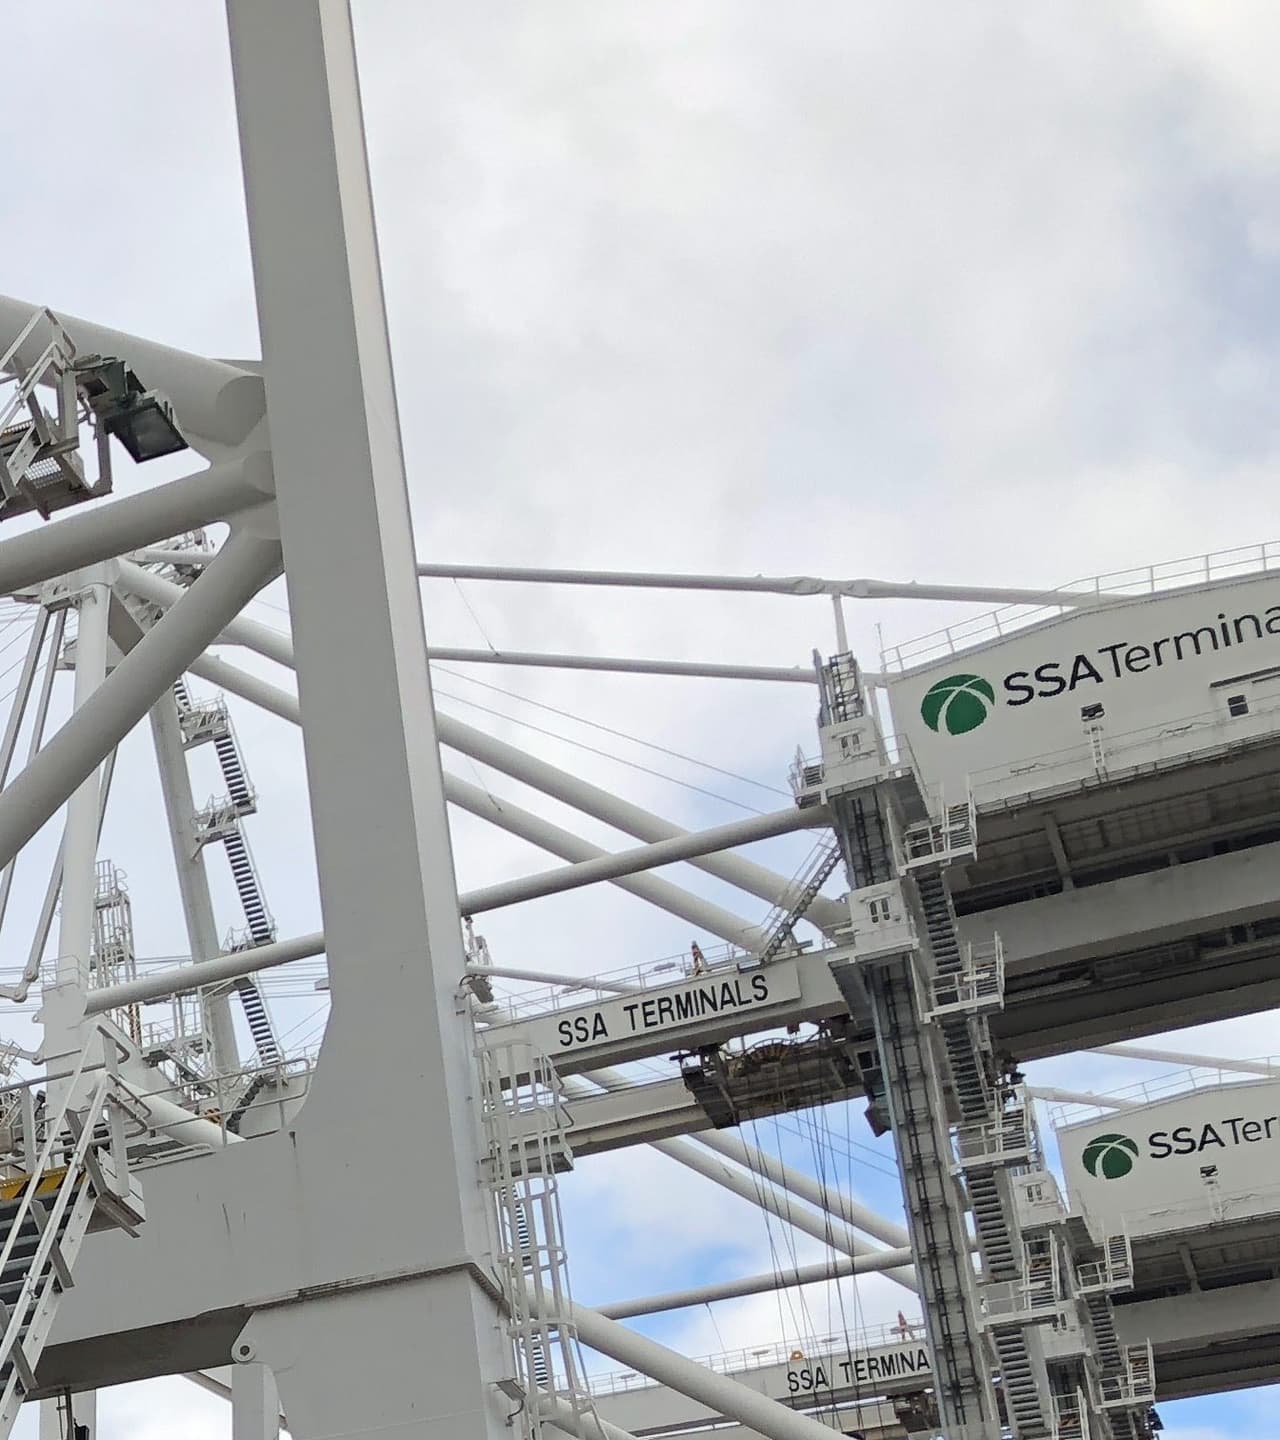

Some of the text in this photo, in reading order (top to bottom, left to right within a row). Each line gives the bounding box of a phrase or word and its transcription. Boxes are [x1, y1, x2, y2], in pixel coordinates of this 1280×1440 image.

[558, 974, 768, 1046] SSA TERMINALS
[787, 1366, 829, 1392] SSA
